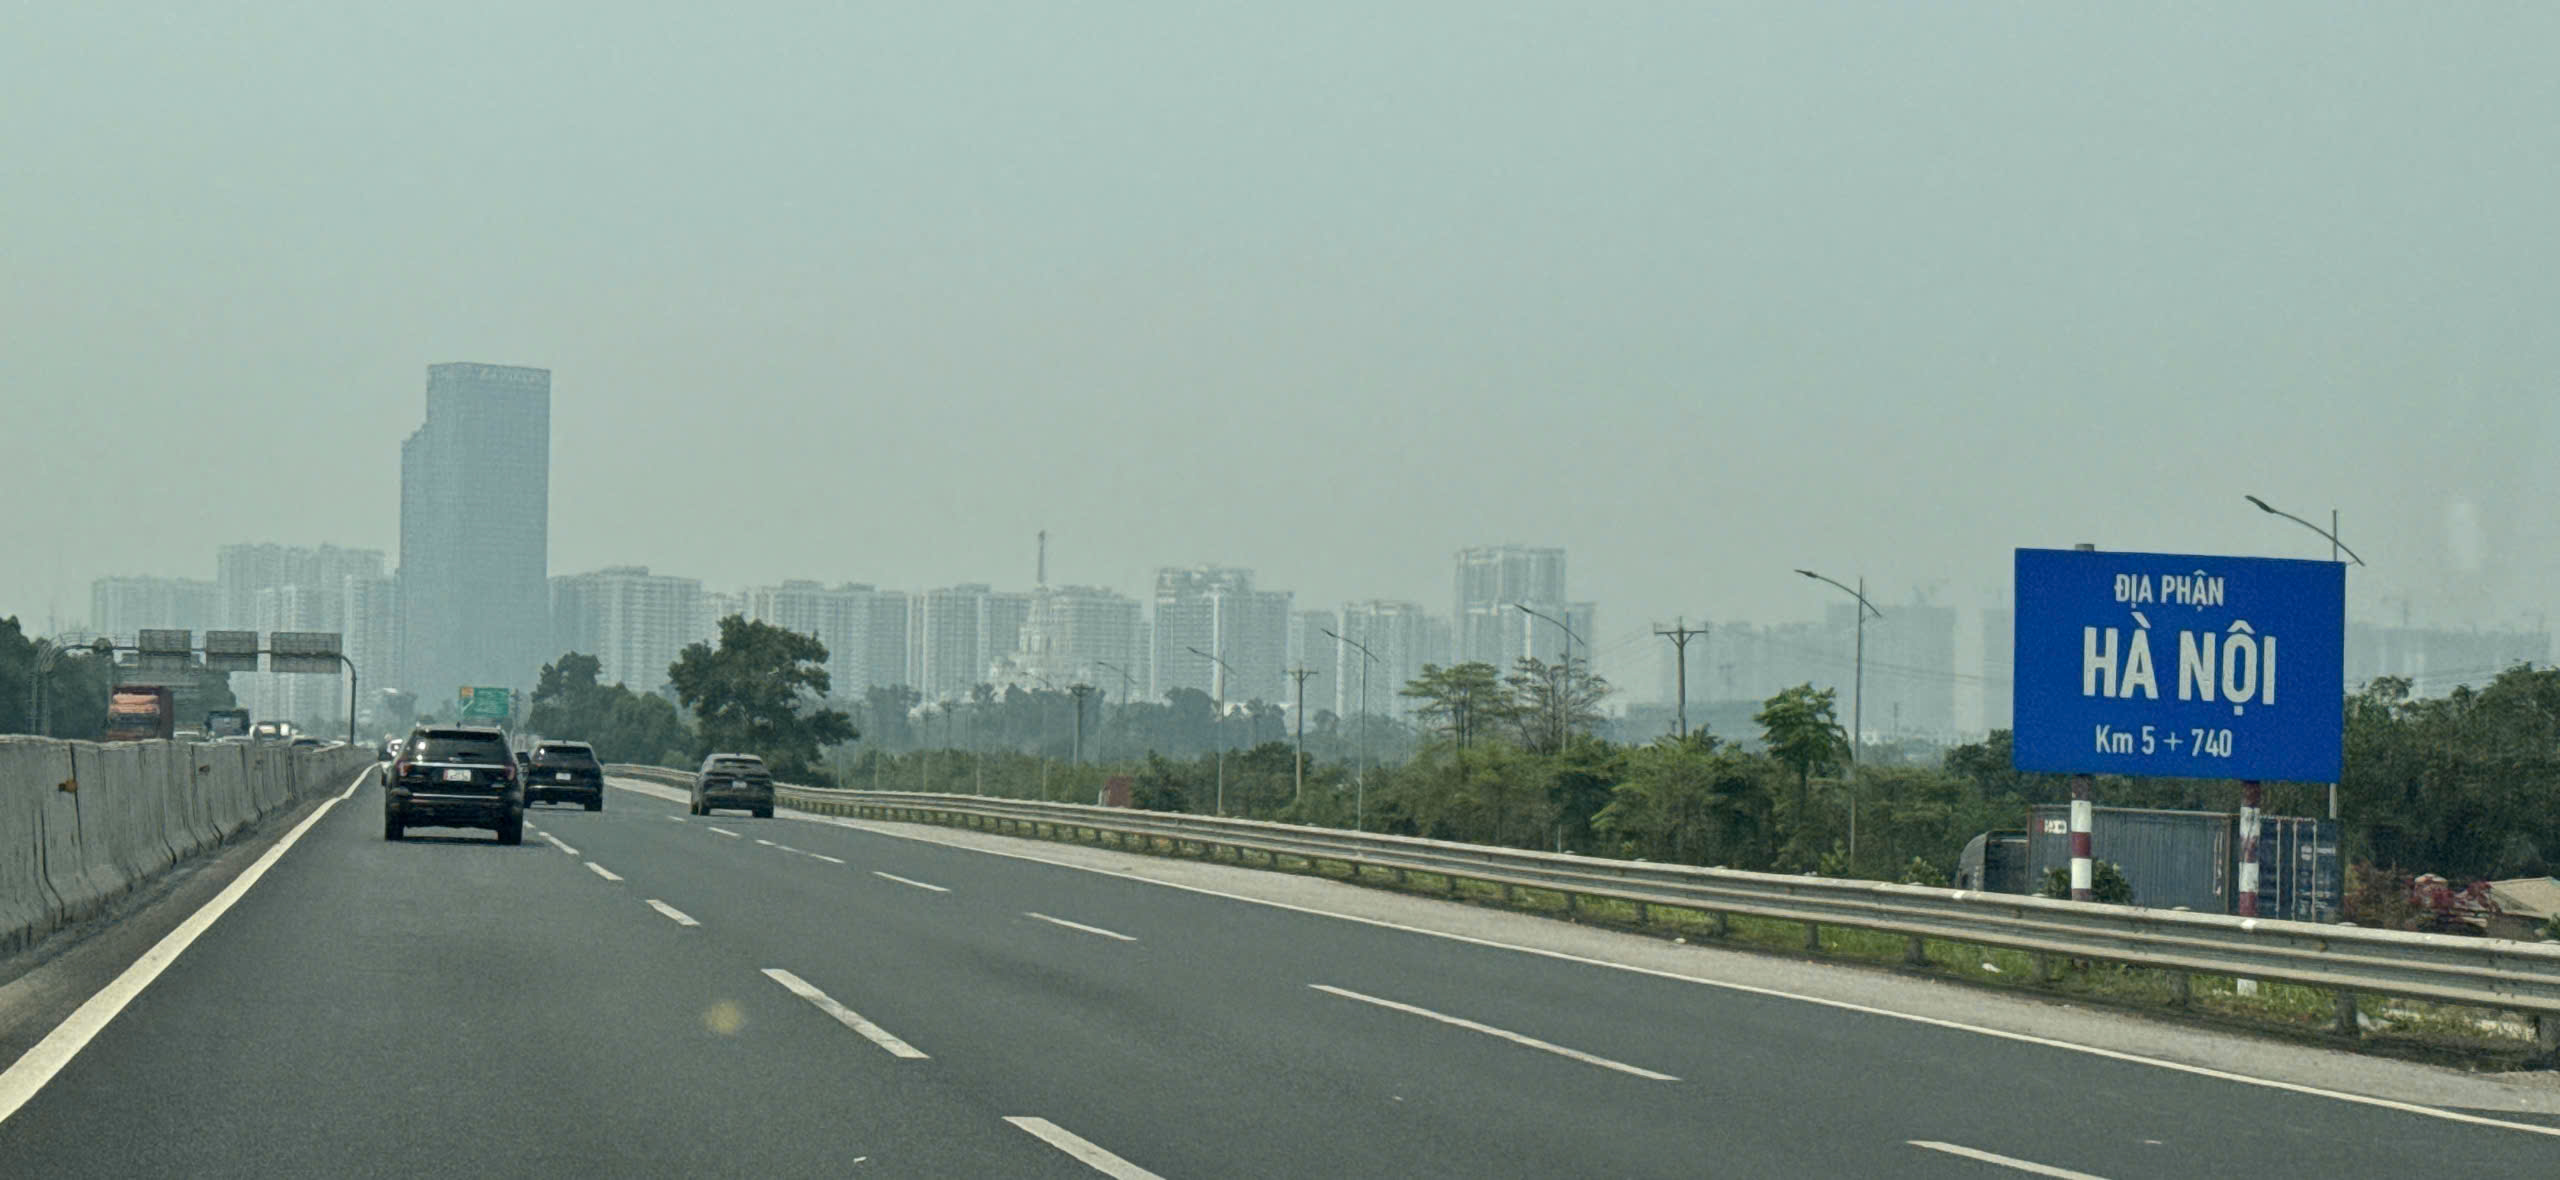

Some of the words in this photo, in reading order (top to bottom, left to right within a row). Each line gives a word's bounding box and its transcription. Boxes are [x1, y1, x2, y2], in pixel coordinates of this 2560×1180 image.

[2114, 573, 2153, 609] ĐỊA
[2160, 569, 2224, 611] PHẬN
[2083, 611, 2159, 699] HÀ
[2178, 619, 2277, 716] NỘI
[2096, 725, 2133, 755] Km
[2142, 726, 2156, 755] 5
[2163, 731, 2183, 752] +
[2191, 728, 2233, 758] 740
